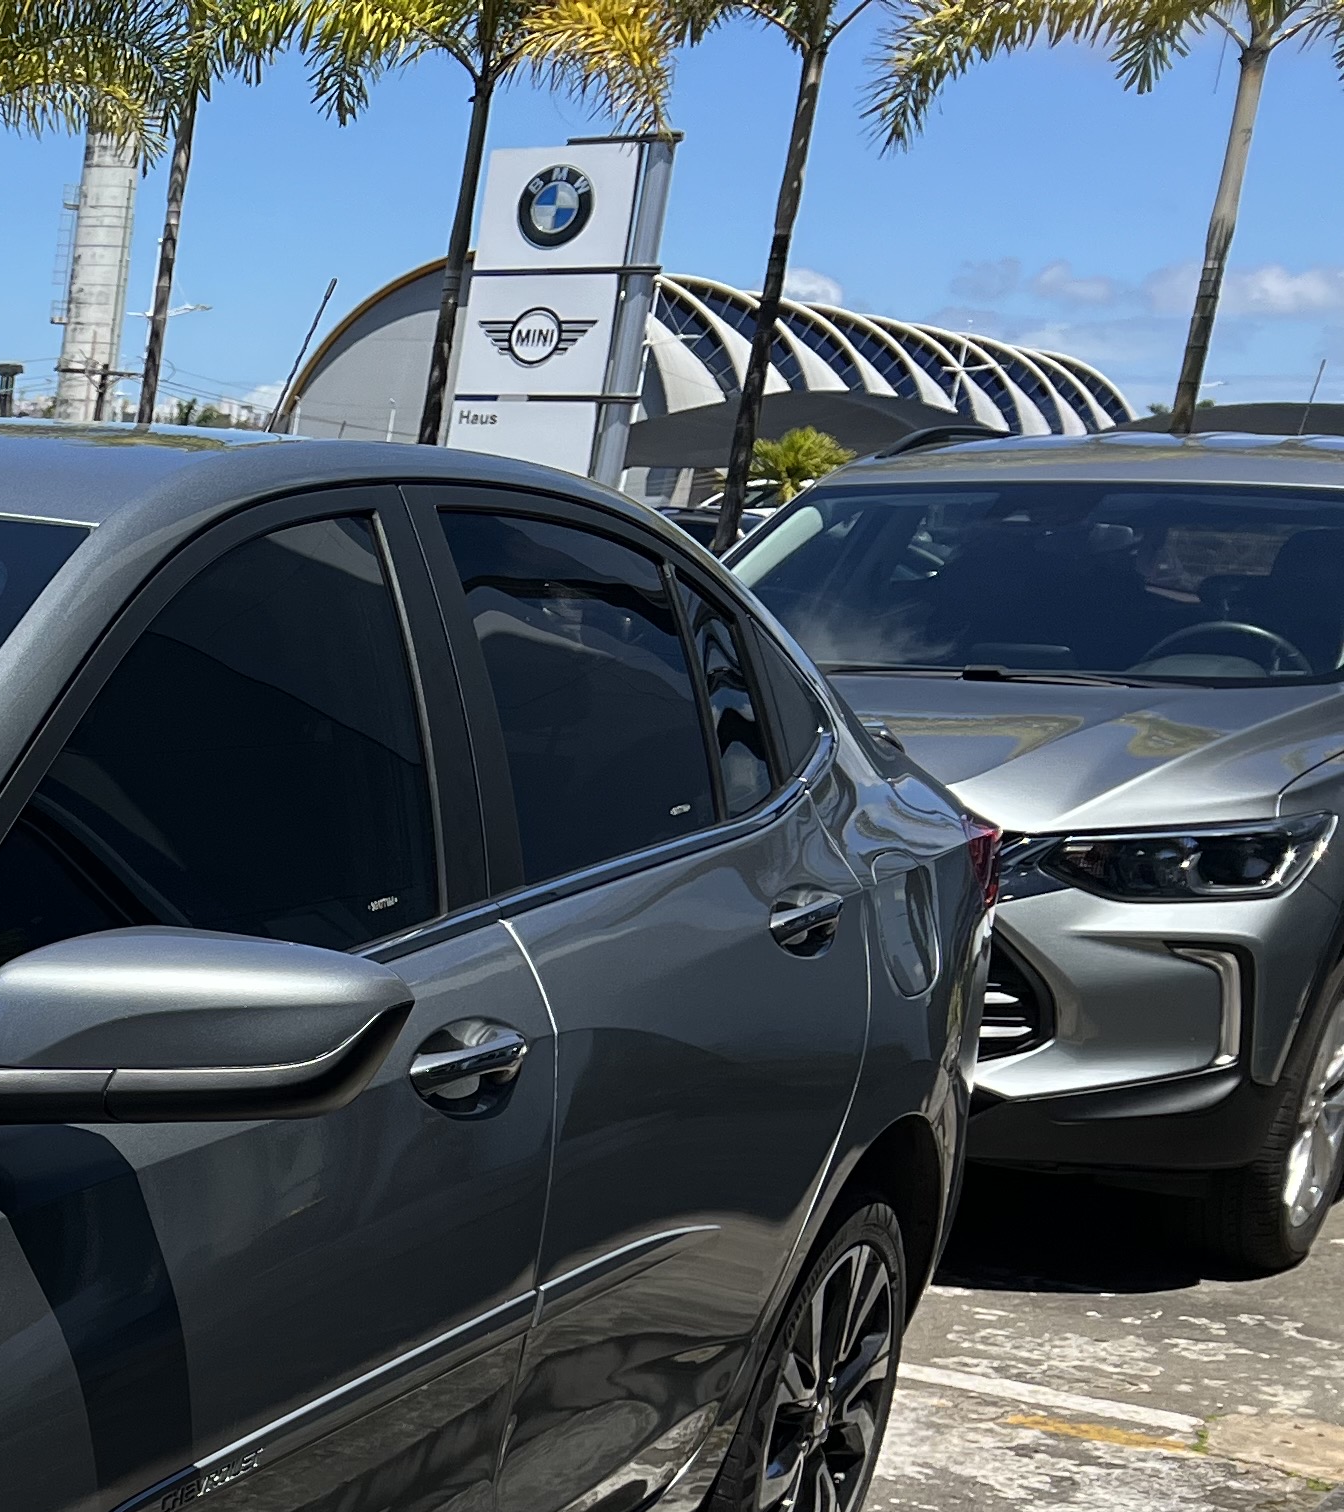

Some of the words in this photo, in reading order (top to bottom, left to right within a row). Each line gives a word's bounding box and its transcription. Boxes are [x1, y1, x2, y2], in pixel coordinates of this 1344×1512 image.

[527, 166, 591, 194] BMW
[515, 328, 555, 348] MINI
[457, 410, 498, 426] Haus
